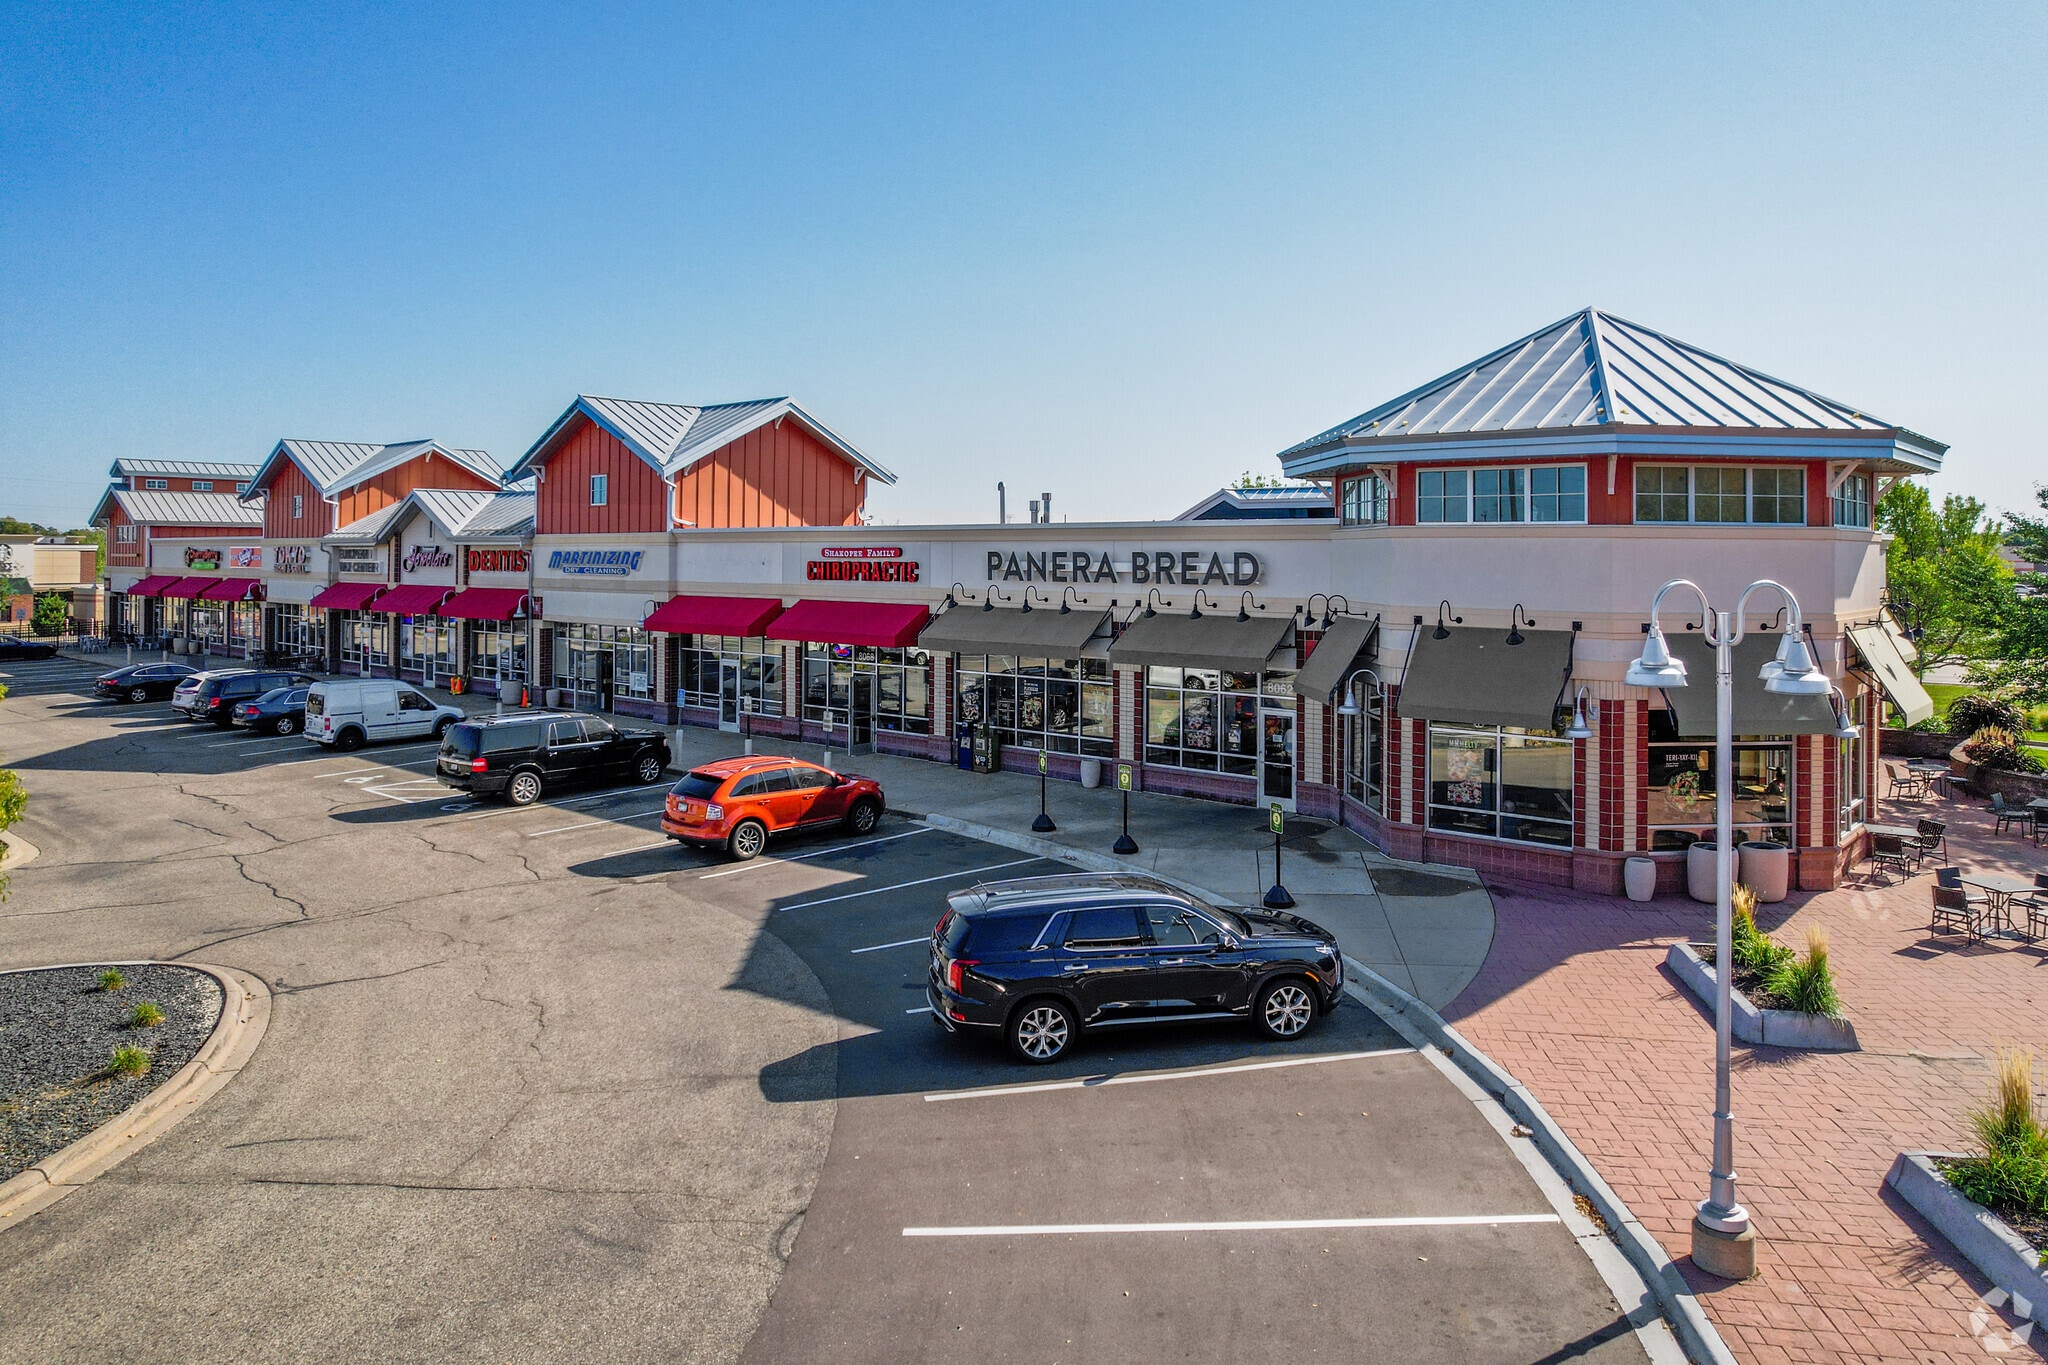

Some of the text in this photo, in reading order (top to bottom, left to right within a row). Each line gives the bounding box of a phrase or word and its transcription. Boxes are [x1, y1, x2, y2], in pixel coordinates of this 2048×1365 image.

[867, 549, 896, 557] FAMILY
[583, 567, 623, 575] CLEANING
[807, 560, 919, 582] CHIROPRACTIC
[987, 551, 1257, 585] PANERA BREAD
[1267, 682, 1293, 694] 8062
